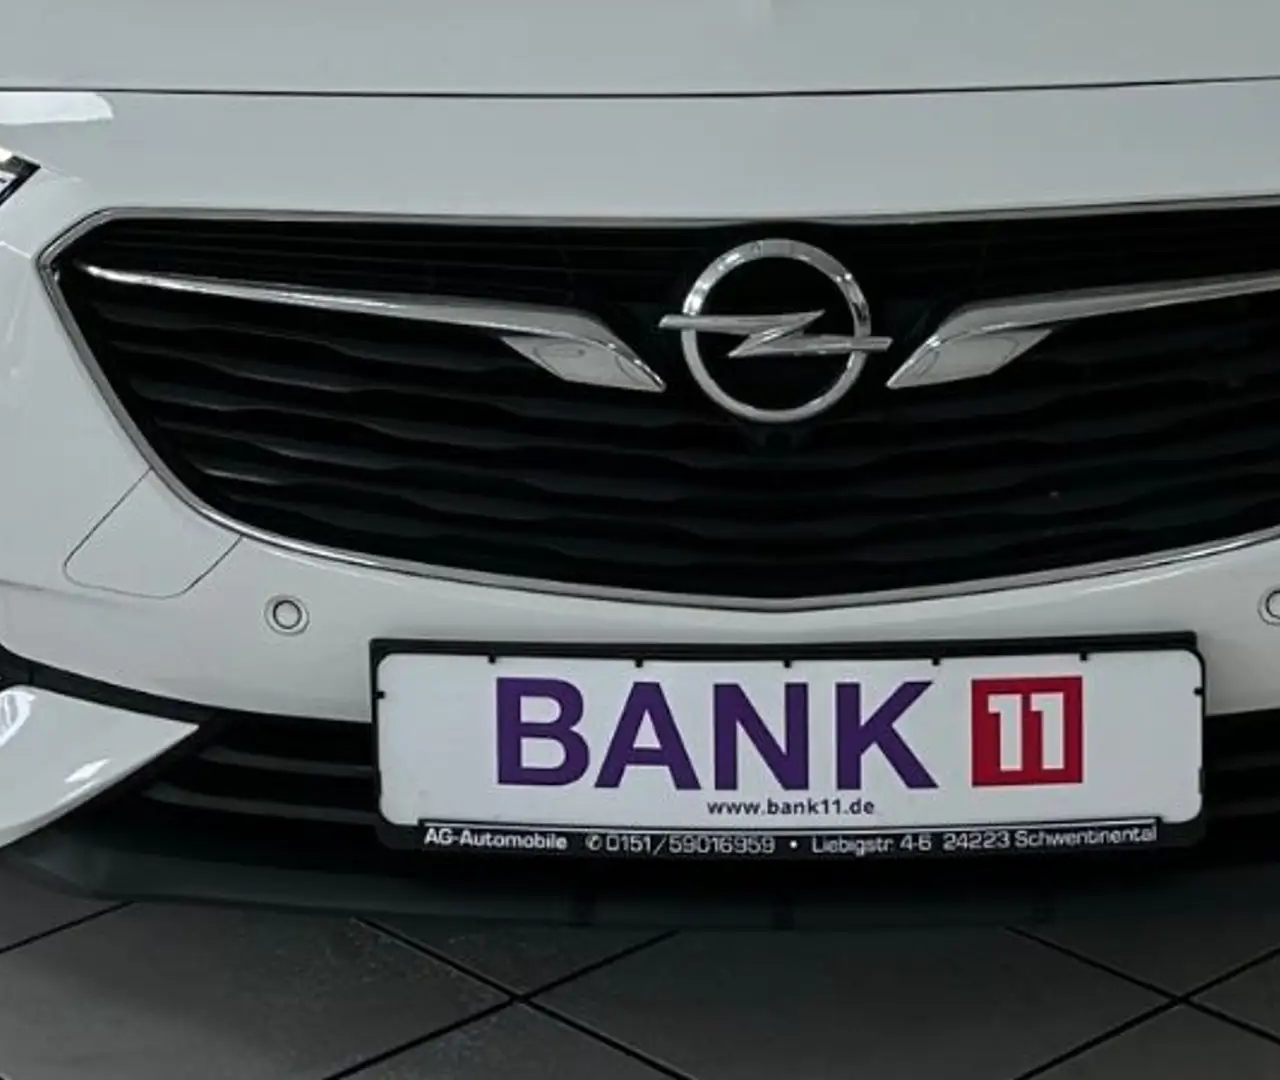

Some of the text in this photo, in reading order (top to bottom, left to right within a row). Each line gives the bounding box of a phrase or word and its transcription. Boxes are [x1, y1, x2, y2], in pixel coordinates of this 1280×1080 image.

[495, 676, 1068, 791] BANK 11
[706, 797, 876, 816] www.bank11.de
[423, 827, 568, 850] AG-Automobile
[899, 834, 933, 852] 4-6
[943, 829, 1011, 851] 24223
